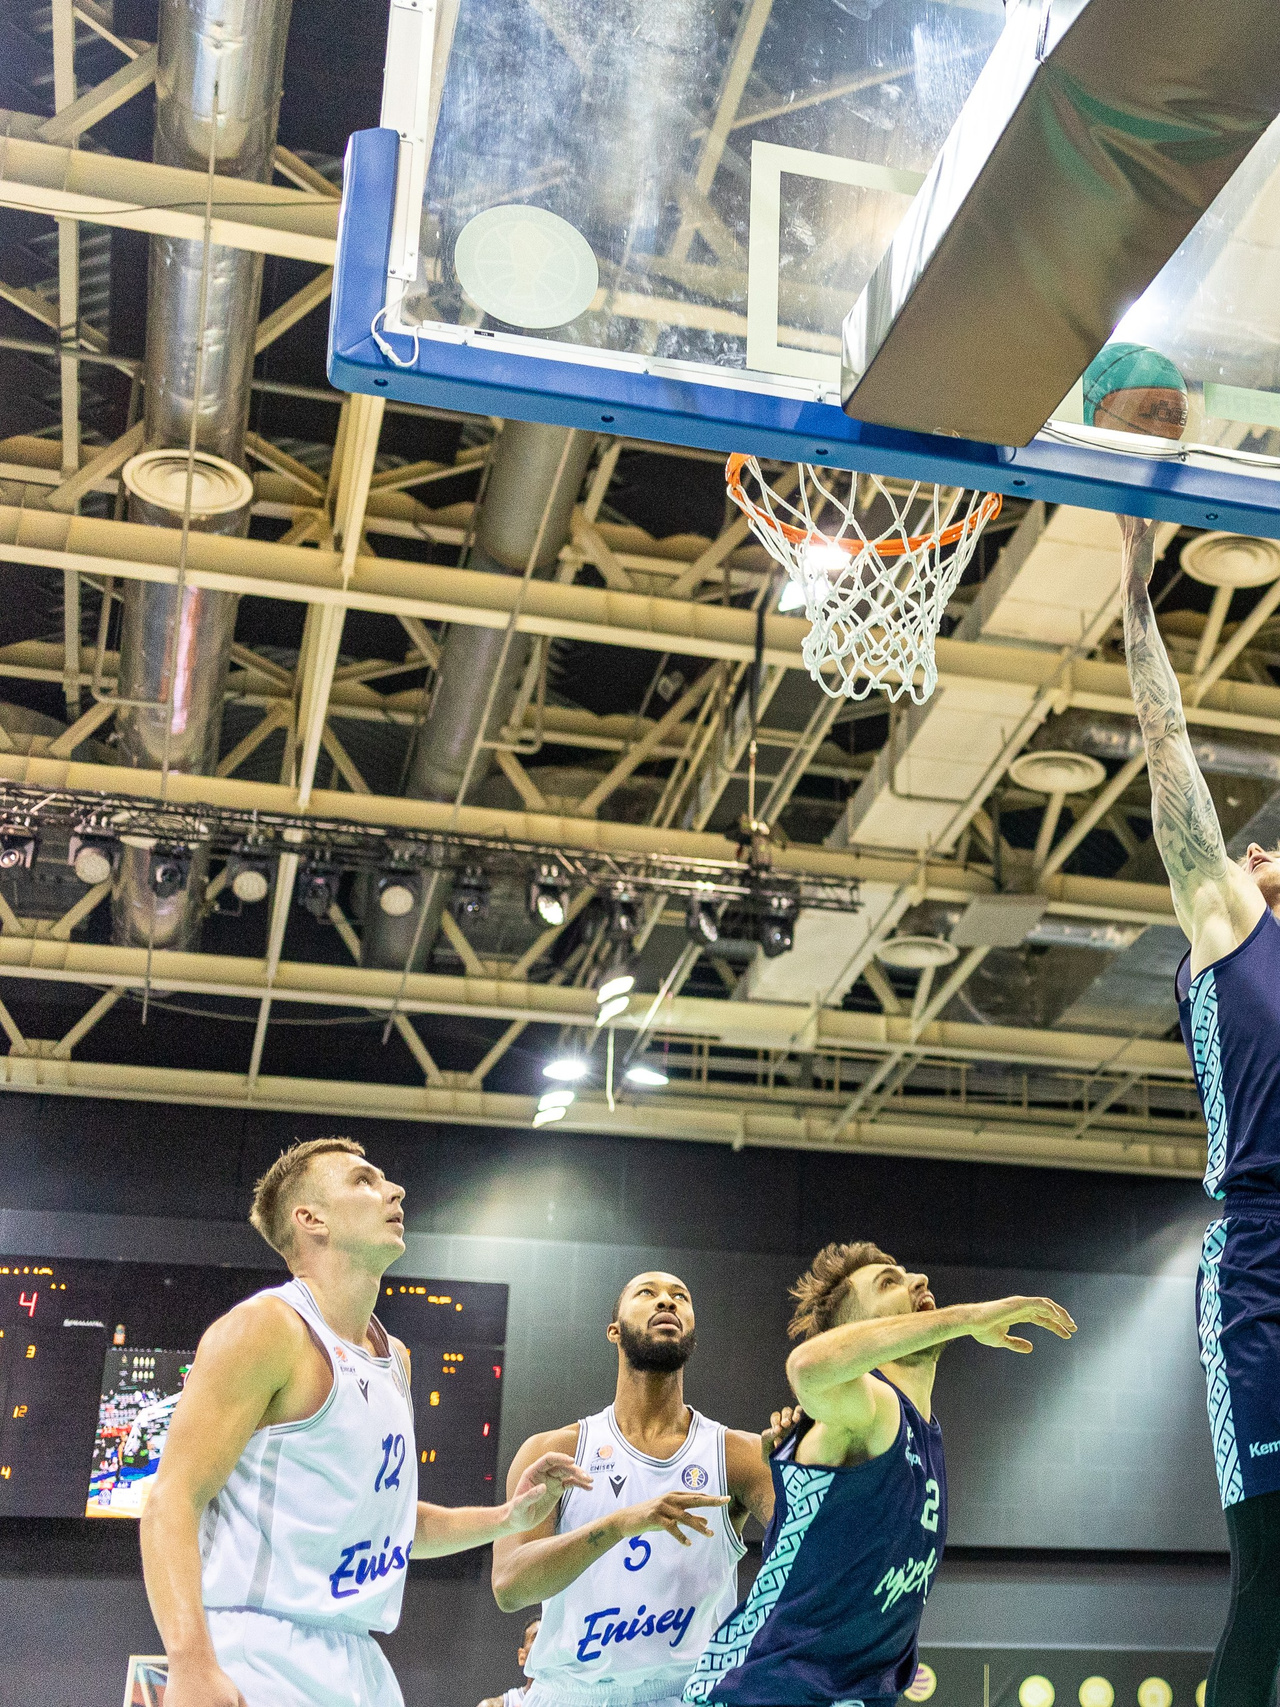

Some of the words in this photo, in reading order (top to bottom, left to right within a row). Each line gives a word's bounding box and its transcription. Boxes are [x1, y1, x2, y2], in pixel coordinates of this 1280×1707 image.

[18, 1291, 38, 1318] 4
[25, 1344, 36, 1359] 3
[12, 1405, 28, 1418] 12
[374, 1433, 406, 1493] 12
[421, 1449, 437, 1464] 11
[0, 1465, 12, 1480] 4
[920, 1478, 940, 1533] 2
[624, 1534, 651, 1572] 5
[576, 1604, 695, 1663] Enisey
